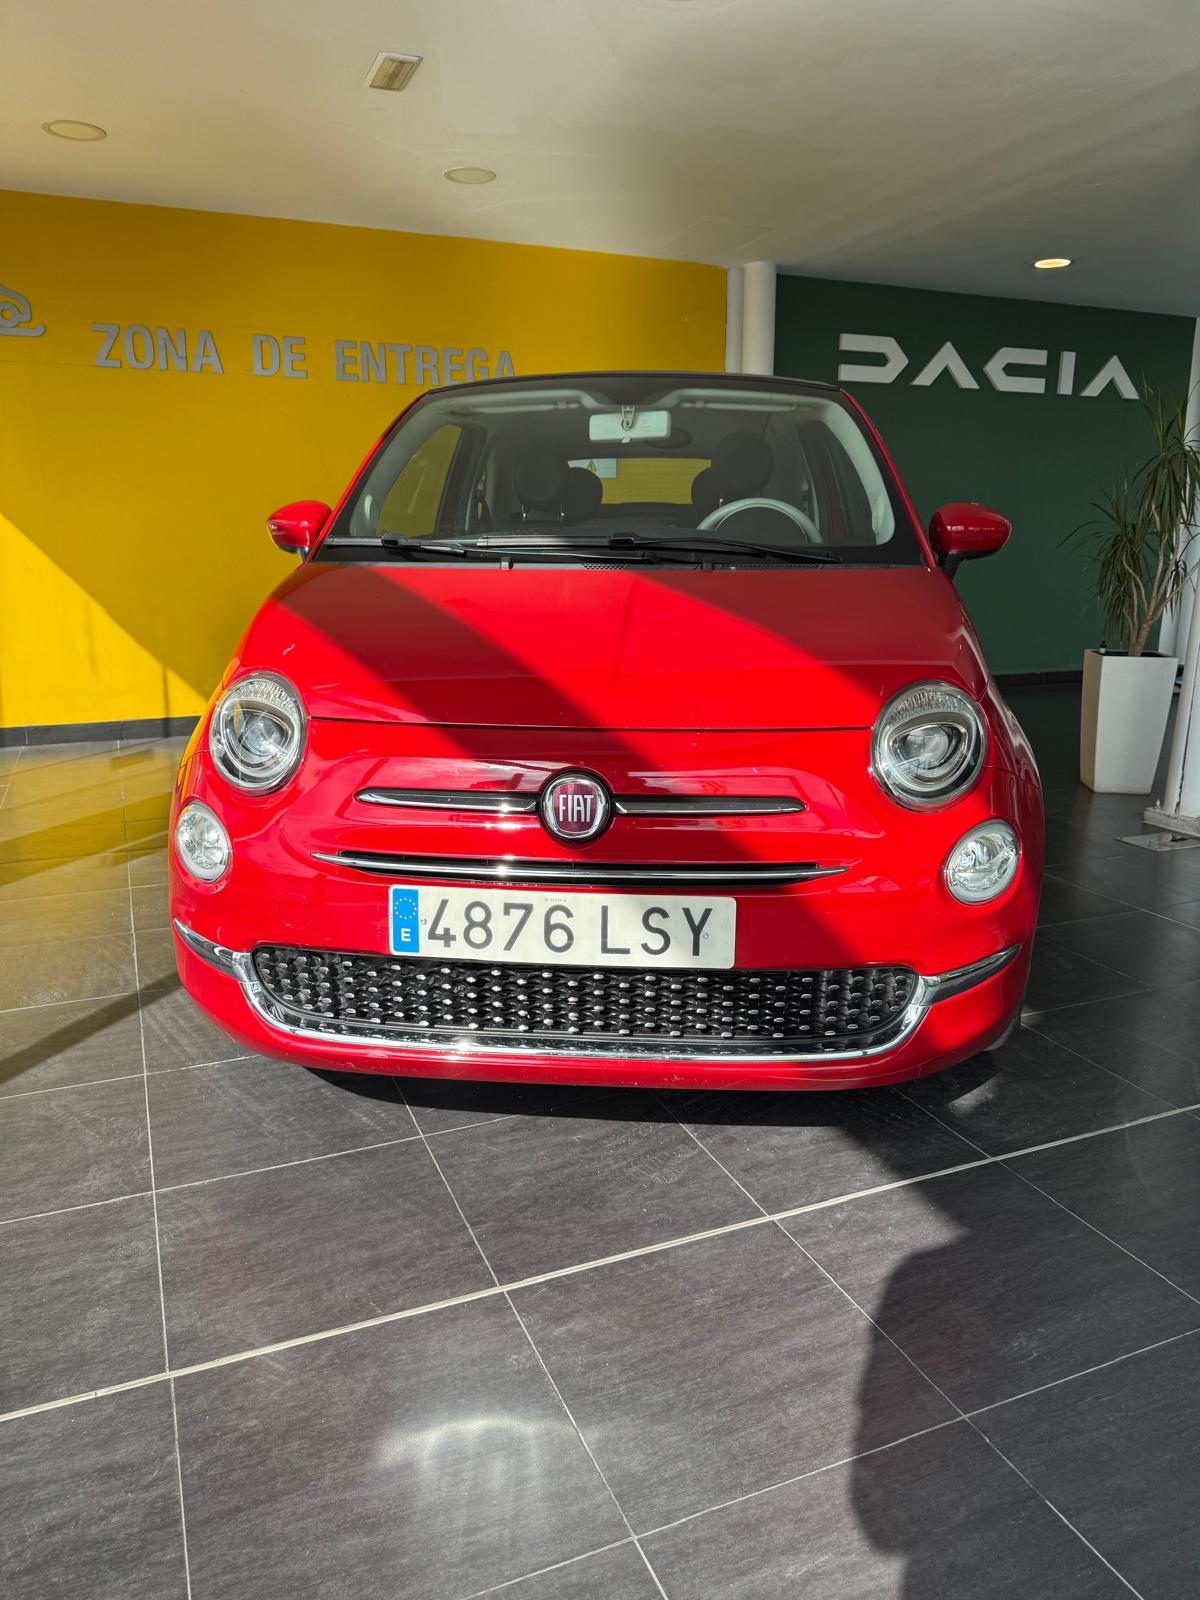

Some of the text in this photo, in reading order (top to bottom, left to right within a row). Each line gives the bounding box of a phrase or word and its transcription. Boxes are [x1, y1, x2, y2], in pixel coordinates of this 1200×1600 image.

[91, 323, 515, 386] ZONA DE ENTREGA
[838, 333, 1140, 399] DACIA
[559, 794, 594, 822] FIAT
[401, 928, 411, 942] E
[427, 898, 713, 957] 4876 LSY
